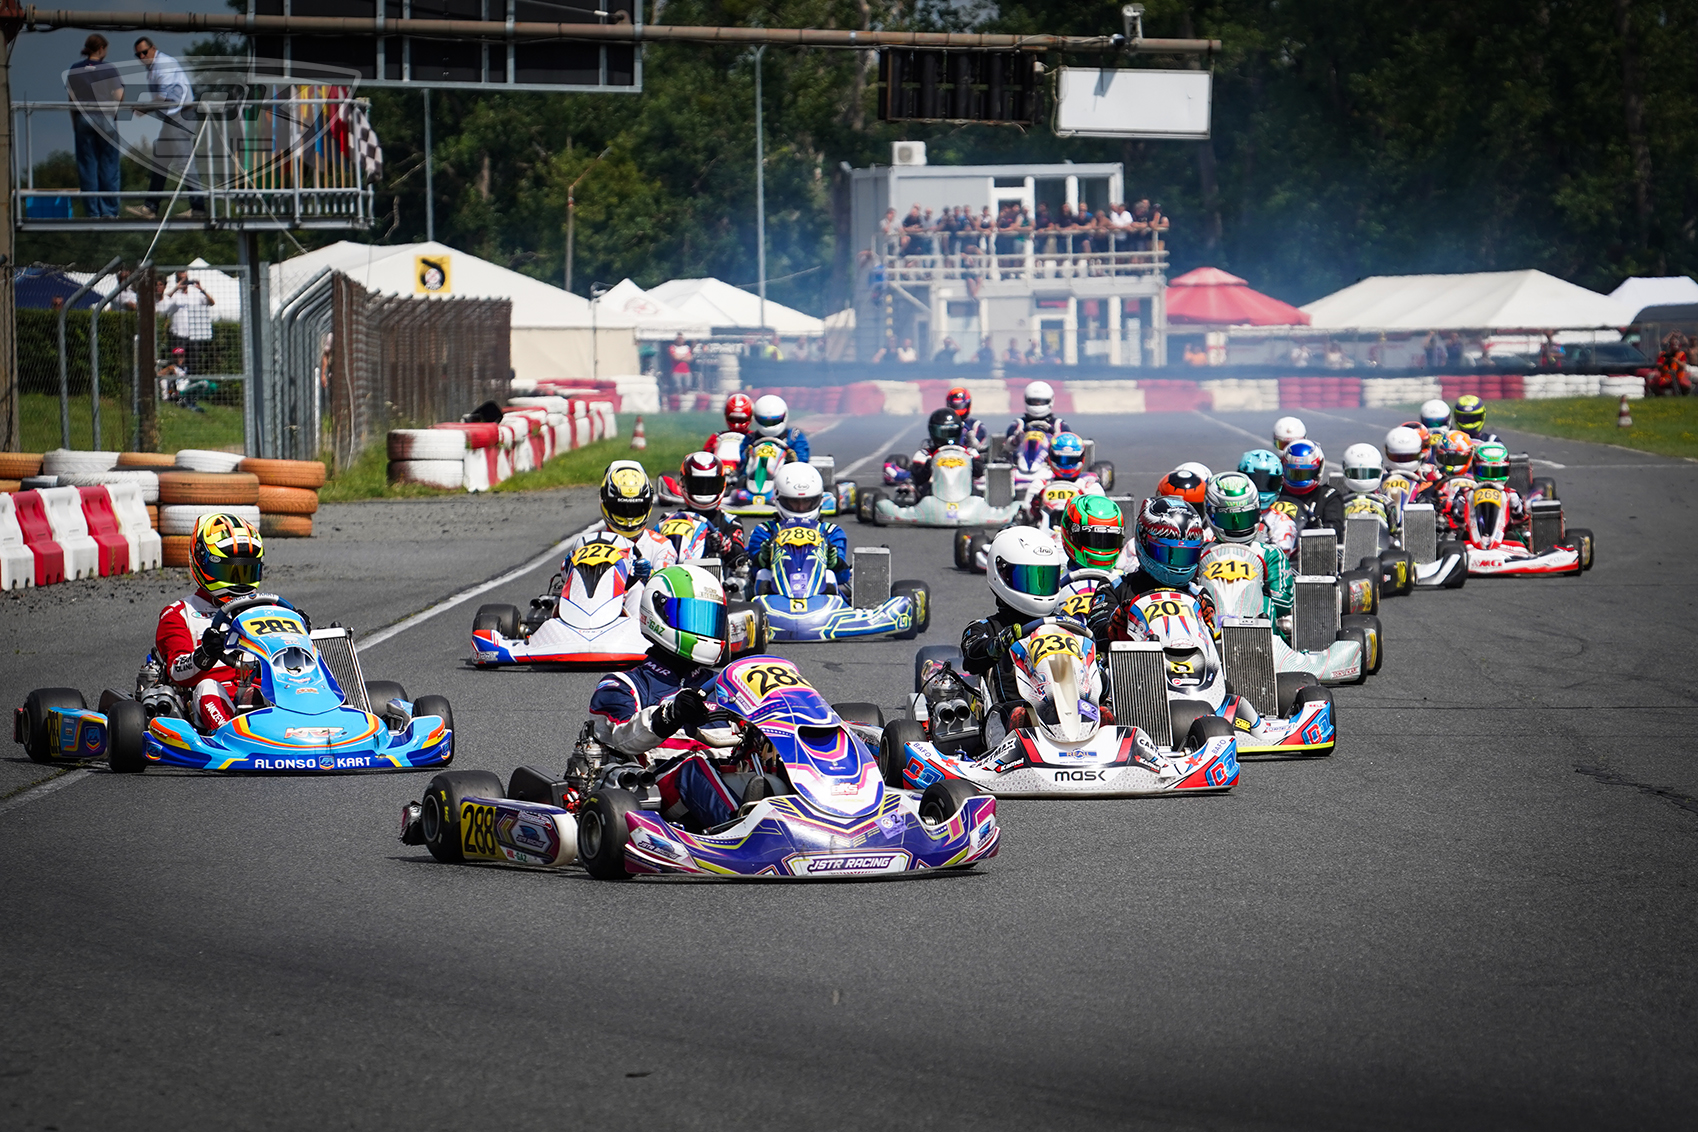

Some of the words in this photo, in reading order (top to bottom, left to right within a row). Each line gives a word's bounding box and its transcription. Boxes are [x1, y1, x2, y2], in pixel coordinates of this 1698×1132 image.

[1477, 489, 1501, 500] 269
[780, 527, 817, 542] 289
[575, 545, 616, 561] 227
[1211, 560, 1250, 577] 211
[250, 619, 303, 636] 283
[1030, 635, 1084, 663] 236
[913, 742, 932, 758] BAFO
[1211, 739, 1227, 754] BAFO
[254, 759, 317, 769] ALONSO
[336, 757, 372, 768] KART
[1054, 770, 1106, 782] mask
[462, 804, 496, 855] 288
[809, 858, 843, 871] JSTR
[846, 856, 891, 869] RACING
